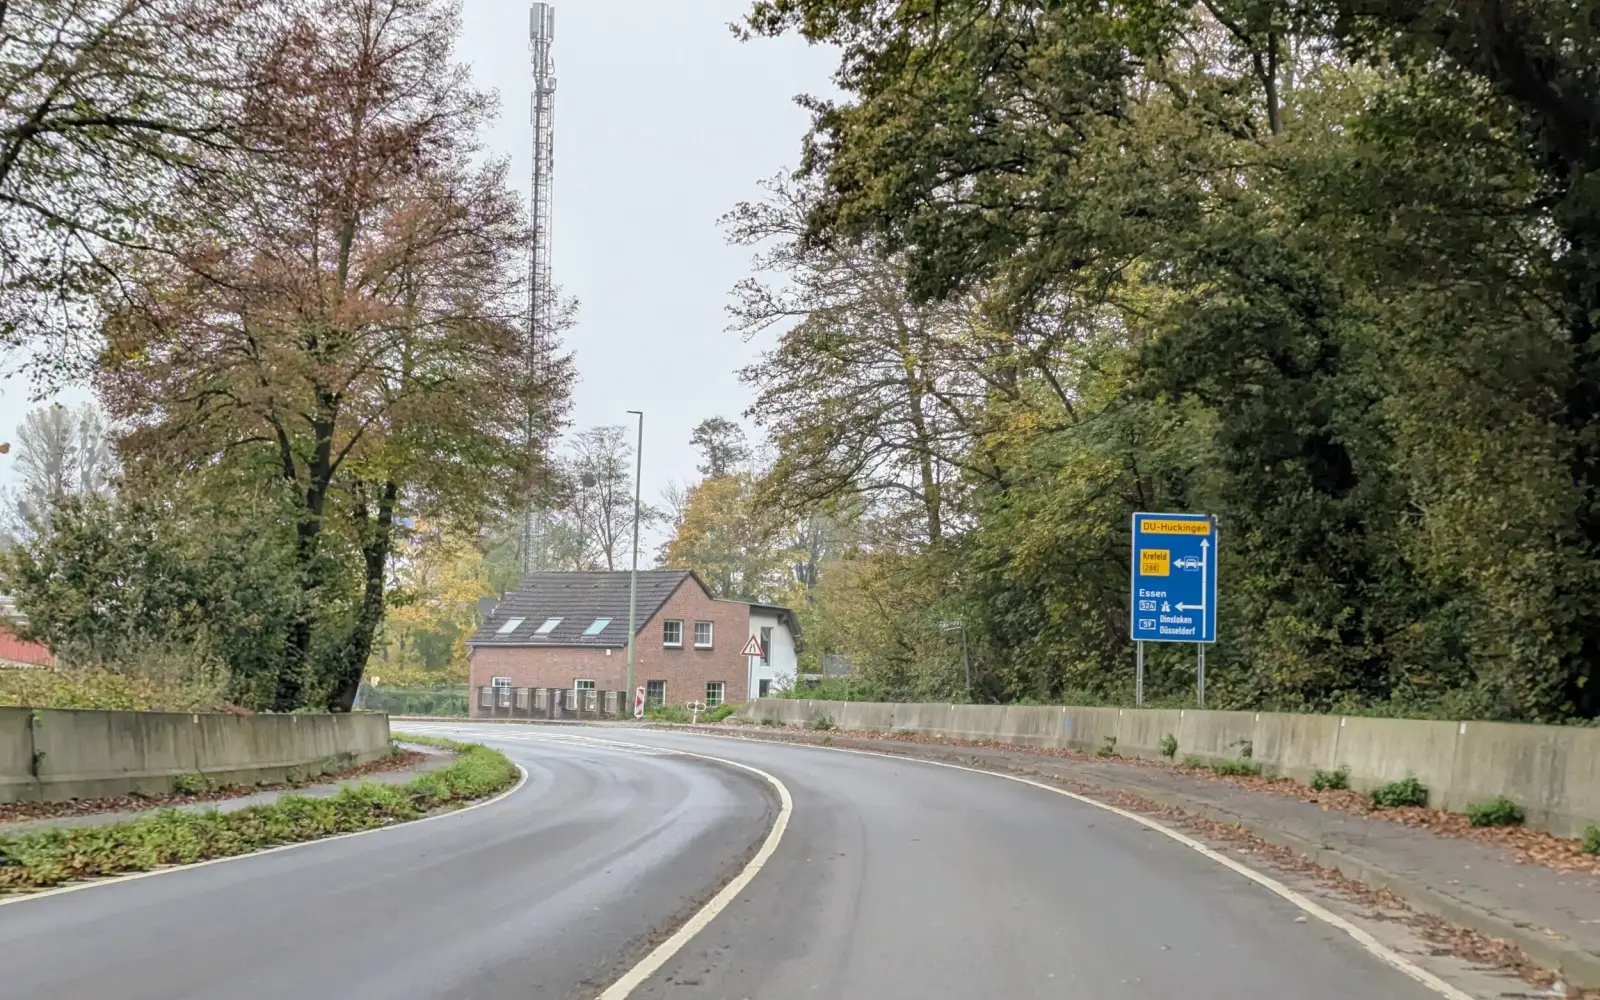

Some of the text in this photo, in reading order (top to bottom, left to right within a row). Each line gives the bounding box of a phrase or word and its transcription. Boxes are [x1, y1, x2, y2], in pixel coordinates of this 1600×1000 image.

[1143, 522, 1208, 533] DU-Huckingen
[1143, 552, 1167, 561] Krefeld
[1139, 588, 1167, 598] Essen
[1160, 614, 1193, 624] Dinslaken
[1160, 626, 1196, 635] Düsseldorf
